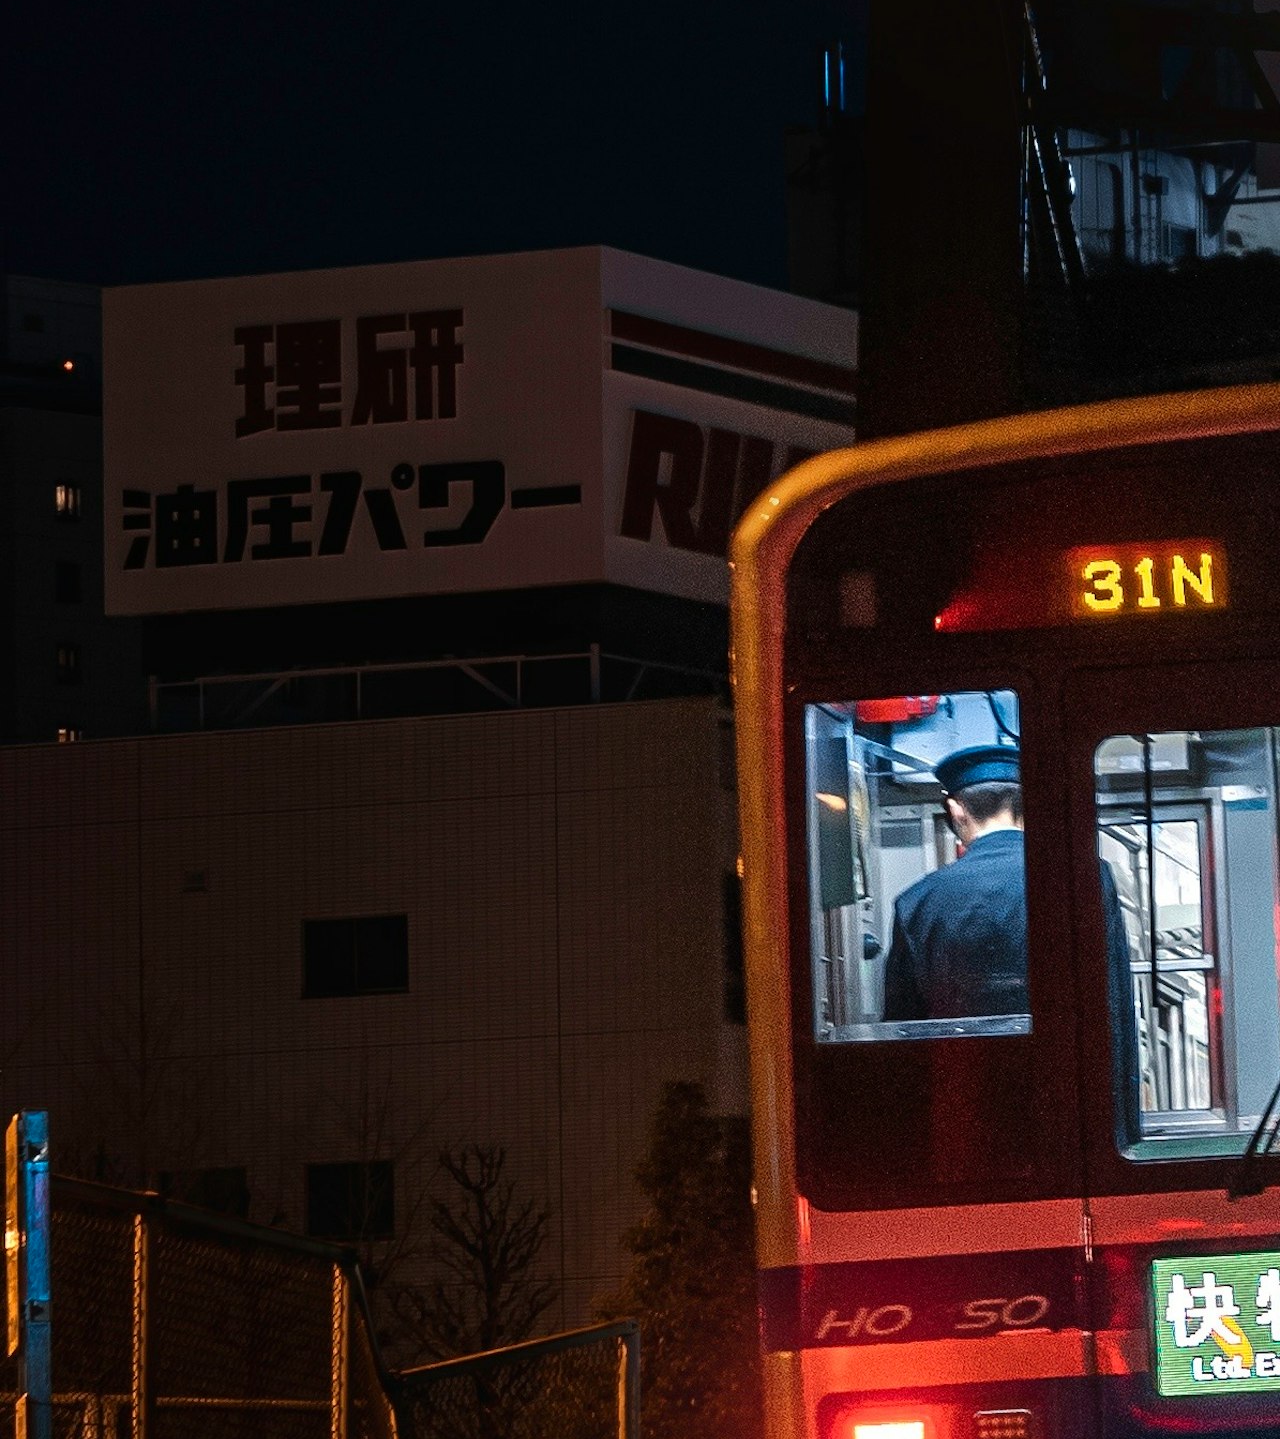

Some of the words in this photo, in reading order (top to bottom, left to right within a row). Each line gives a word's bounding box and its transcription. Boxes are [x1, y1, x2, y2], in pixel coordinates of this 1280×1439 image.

[234, 308, 464, 439] 理研
[122, 459, 582, 571] 油圧パワー
[1081, 551, 1215, 612] 31N
